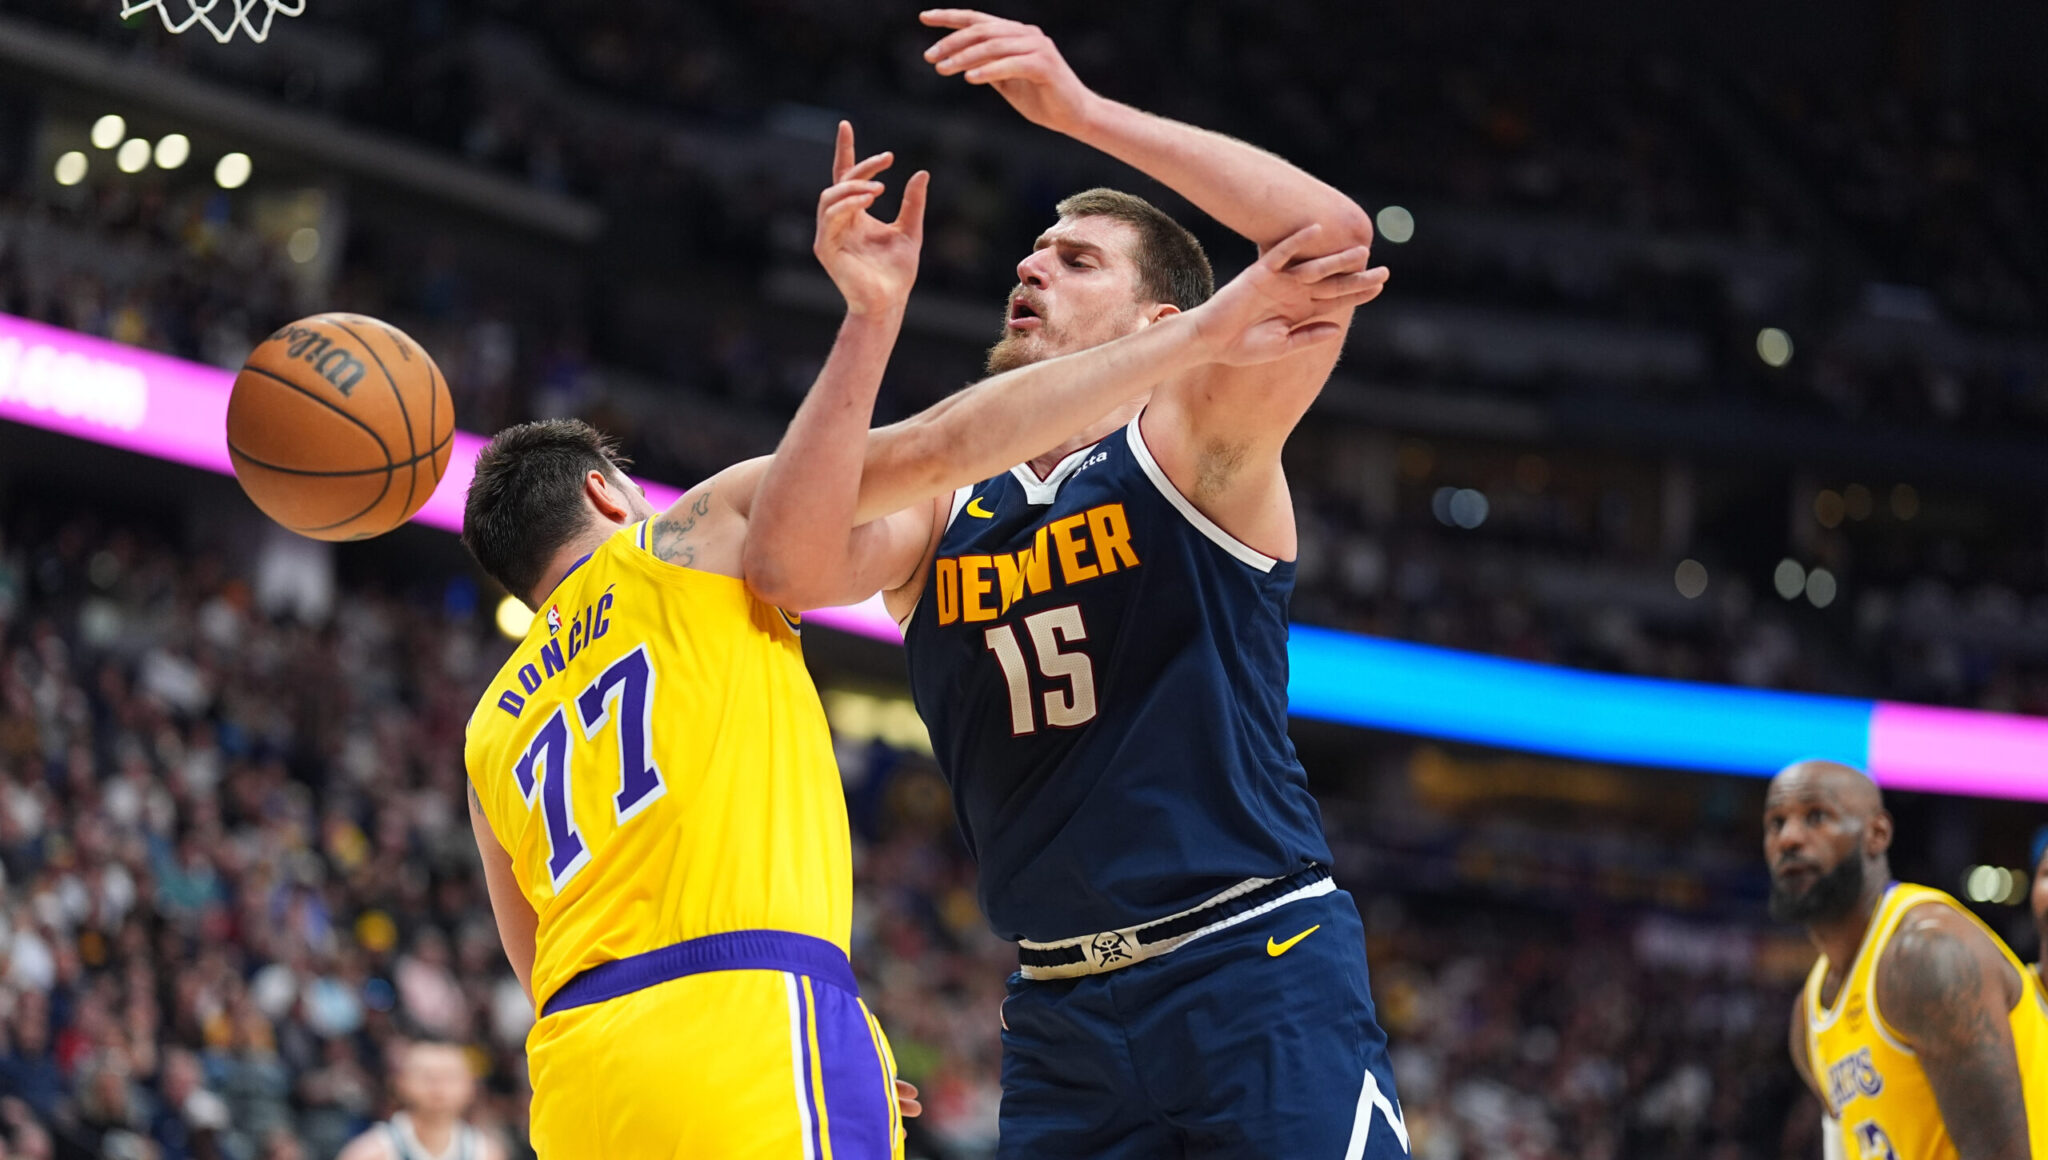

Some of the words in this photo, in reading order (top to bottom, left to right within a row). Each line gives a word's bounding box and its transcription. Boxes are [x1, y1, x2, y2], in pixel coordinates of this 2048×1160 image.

[497, 583, 616, 719] DONČIĆ
[984, 603, 1098, 737] 15
[511, 641, 668, 896] 77
